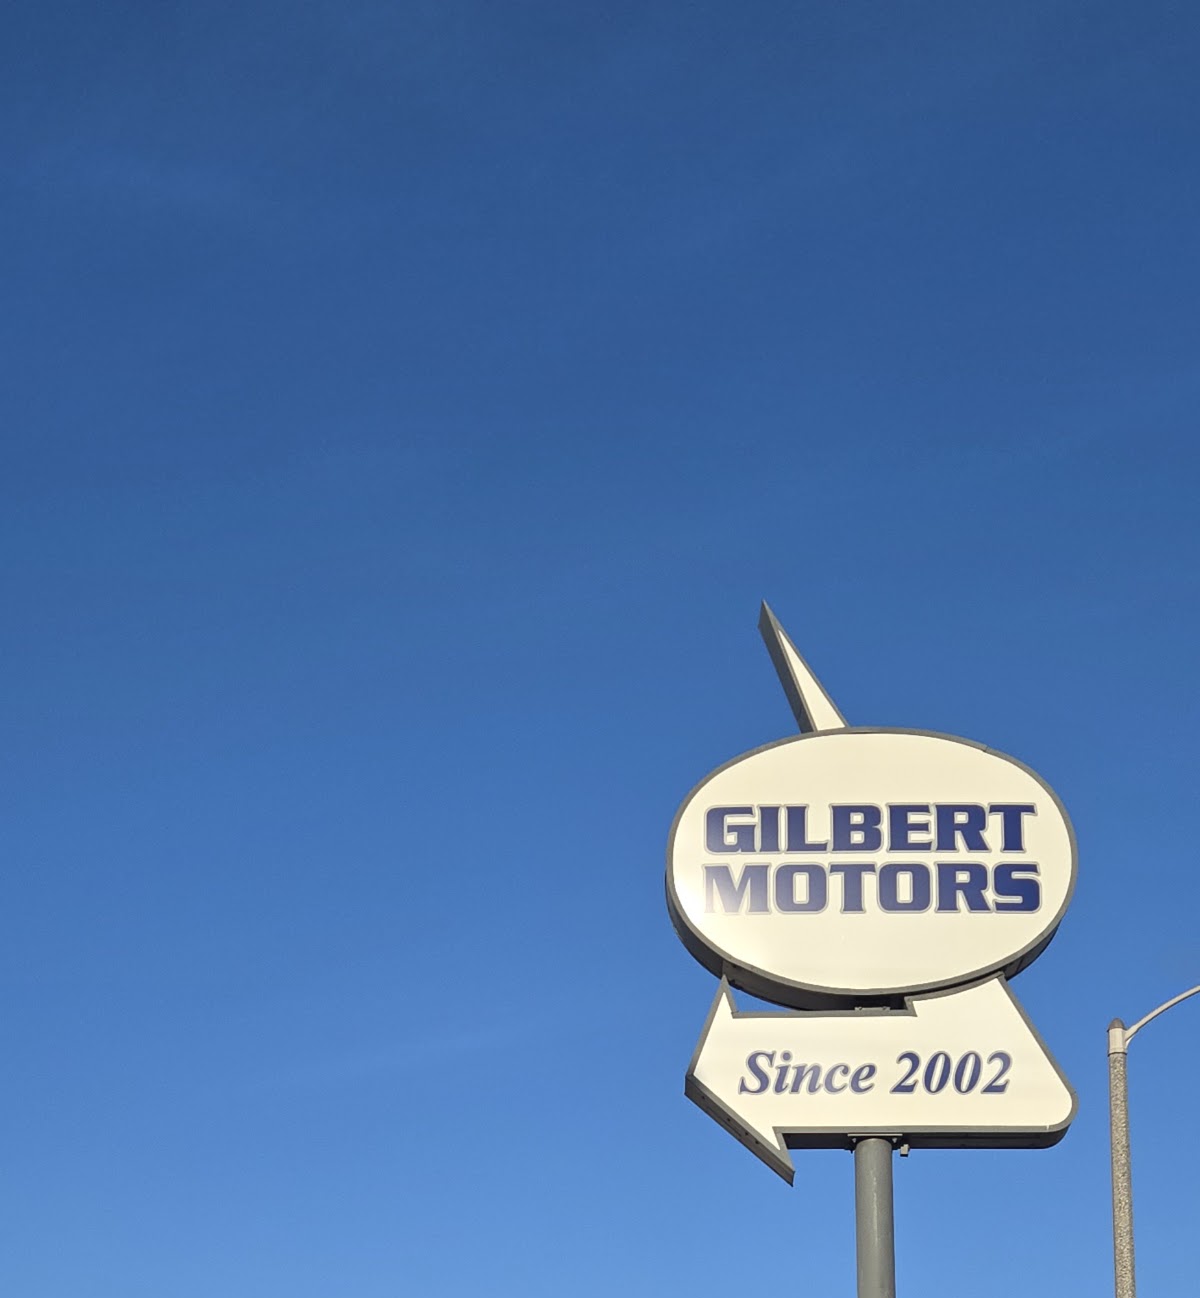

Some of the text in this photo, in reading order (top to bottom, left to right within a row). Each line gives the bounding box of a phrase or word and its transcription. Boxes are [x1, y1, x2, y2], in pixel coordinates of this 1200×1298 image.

[704, 802, 1038, 854] GILBERT
[702, 862, 1042, 914] MOTORS
[738, 1049, 1013, 1095] Since 2002
